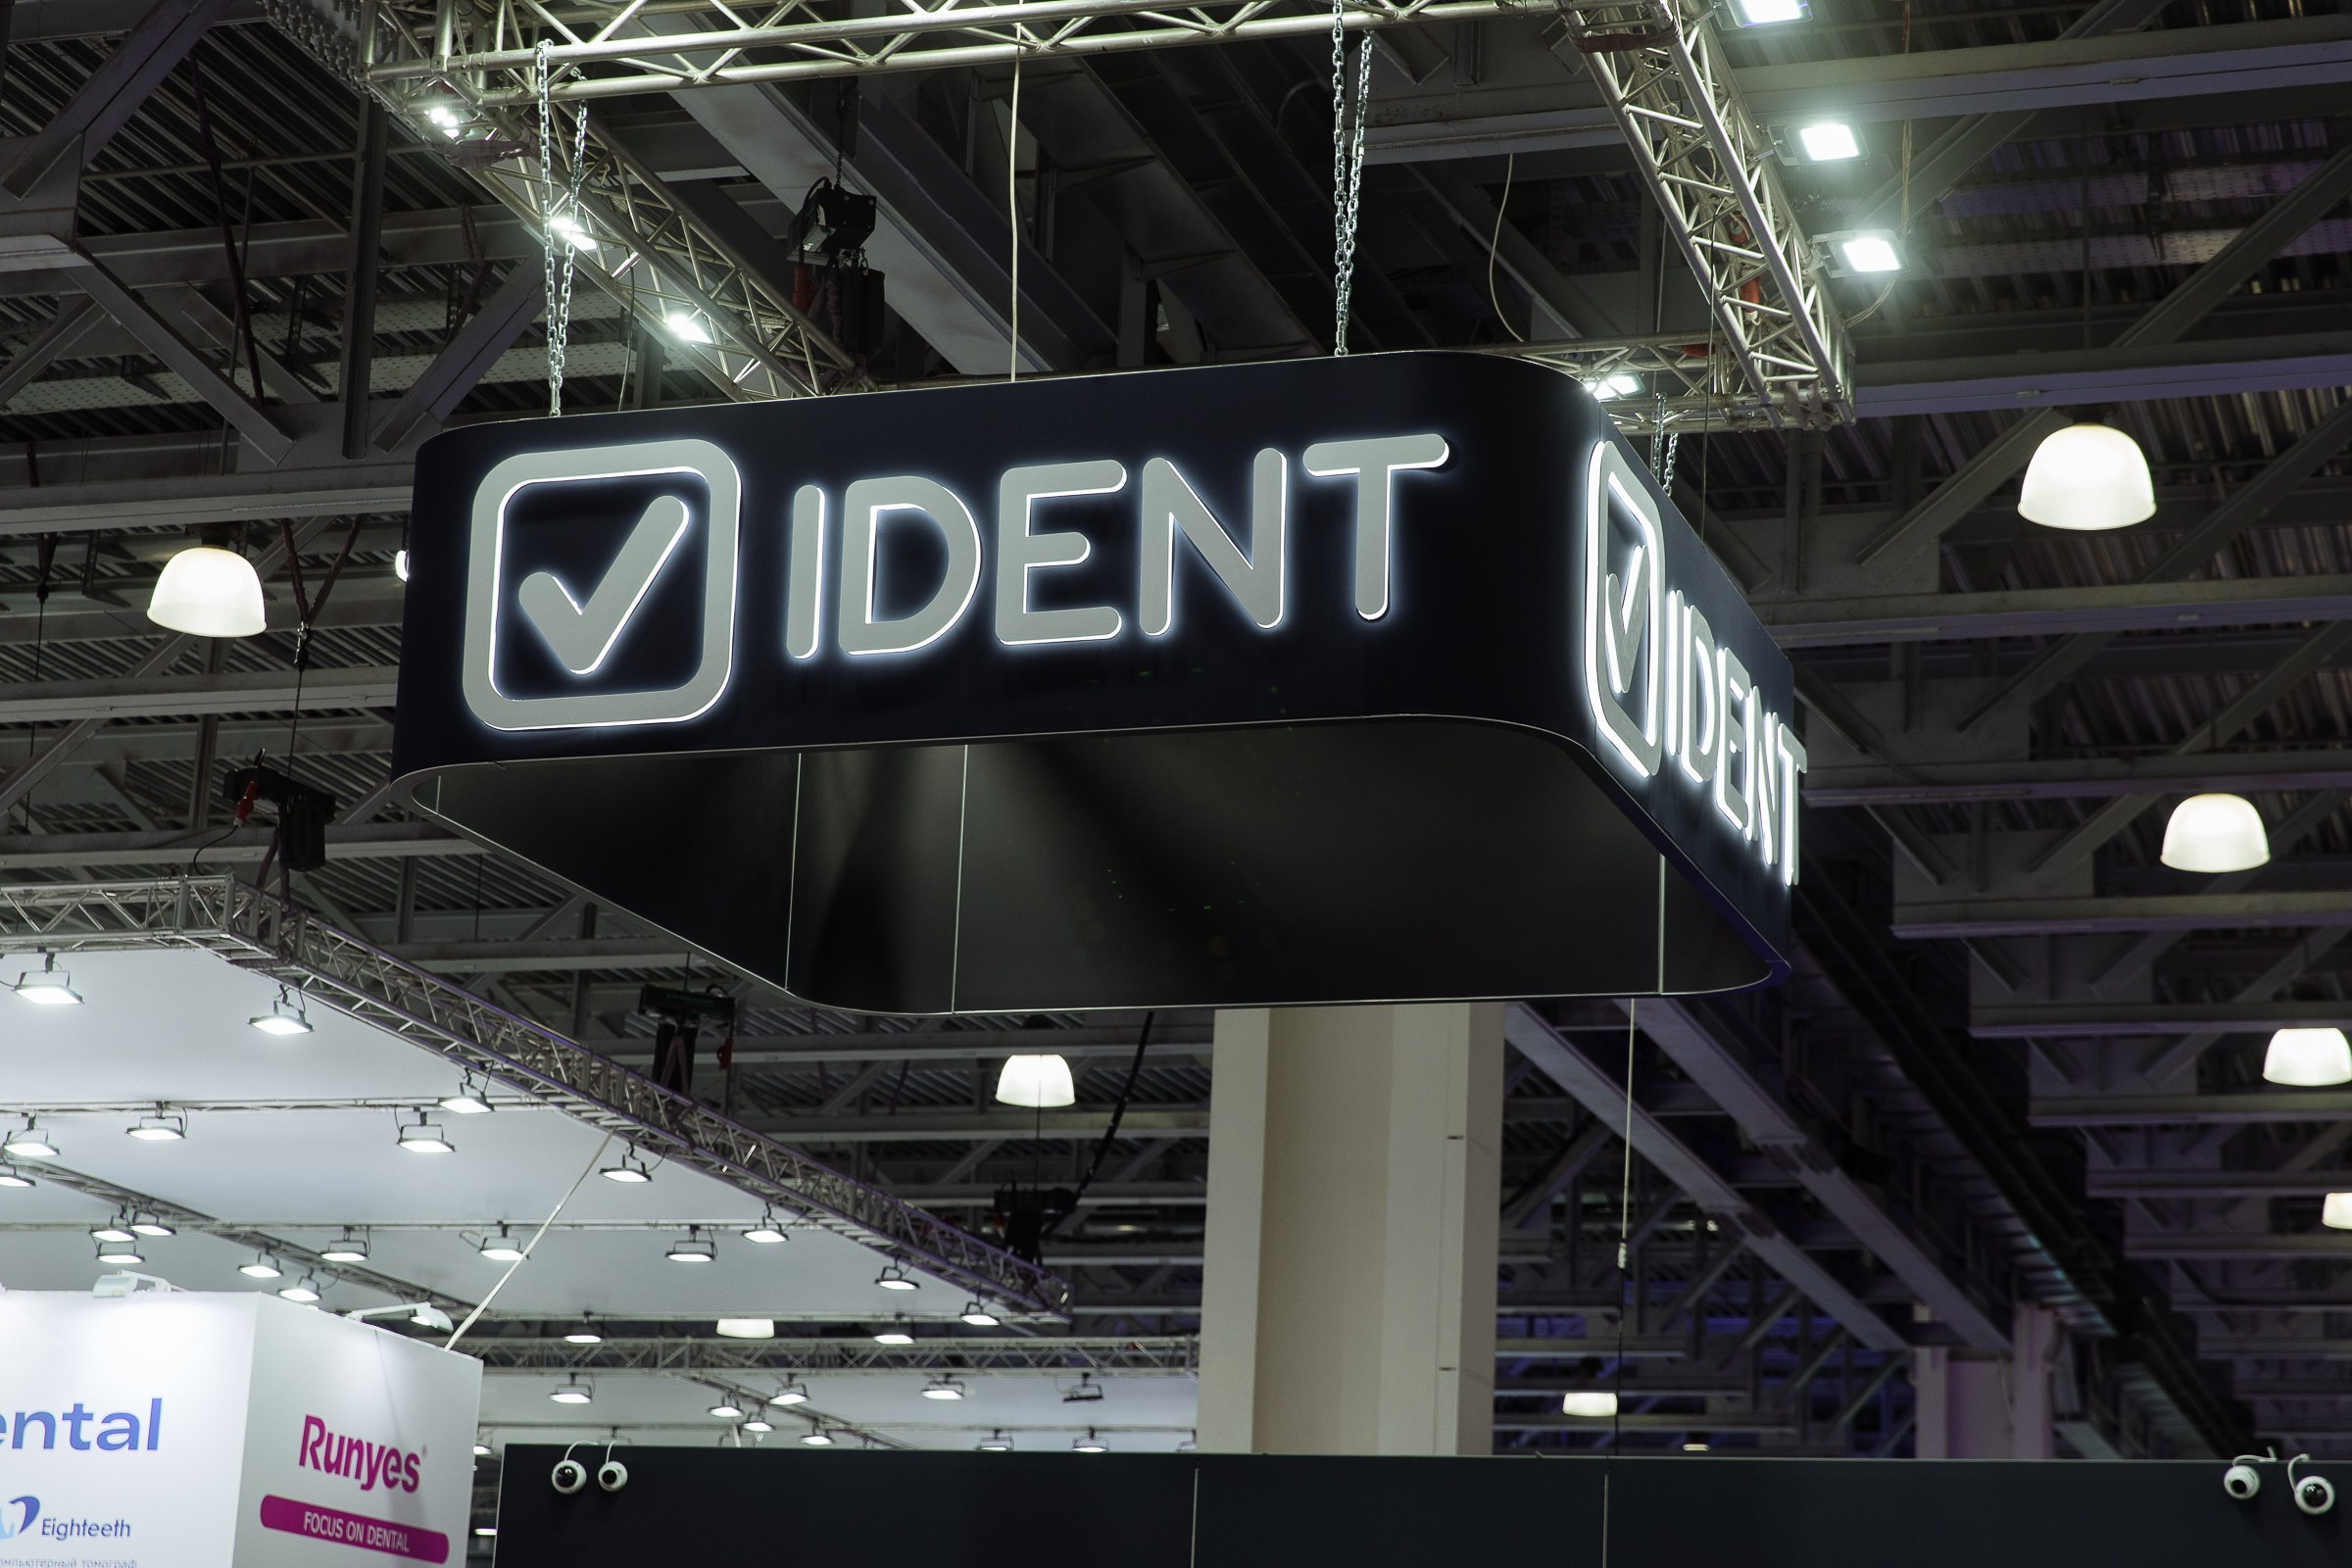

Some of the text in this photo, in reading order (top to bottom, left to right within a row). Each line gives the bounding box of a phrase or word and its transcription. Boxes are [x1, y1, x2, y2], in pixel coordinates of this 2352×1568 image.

[787, 434, 1449, 660] IDENT
[1667, 590, 1807, 886] IDENT
[0, 1398, 162, 1450] ntal
[41, 1518, 131, 1542] Eighteeth
[304, 1511, 410, 1552] FOCUS ON DENTAL
